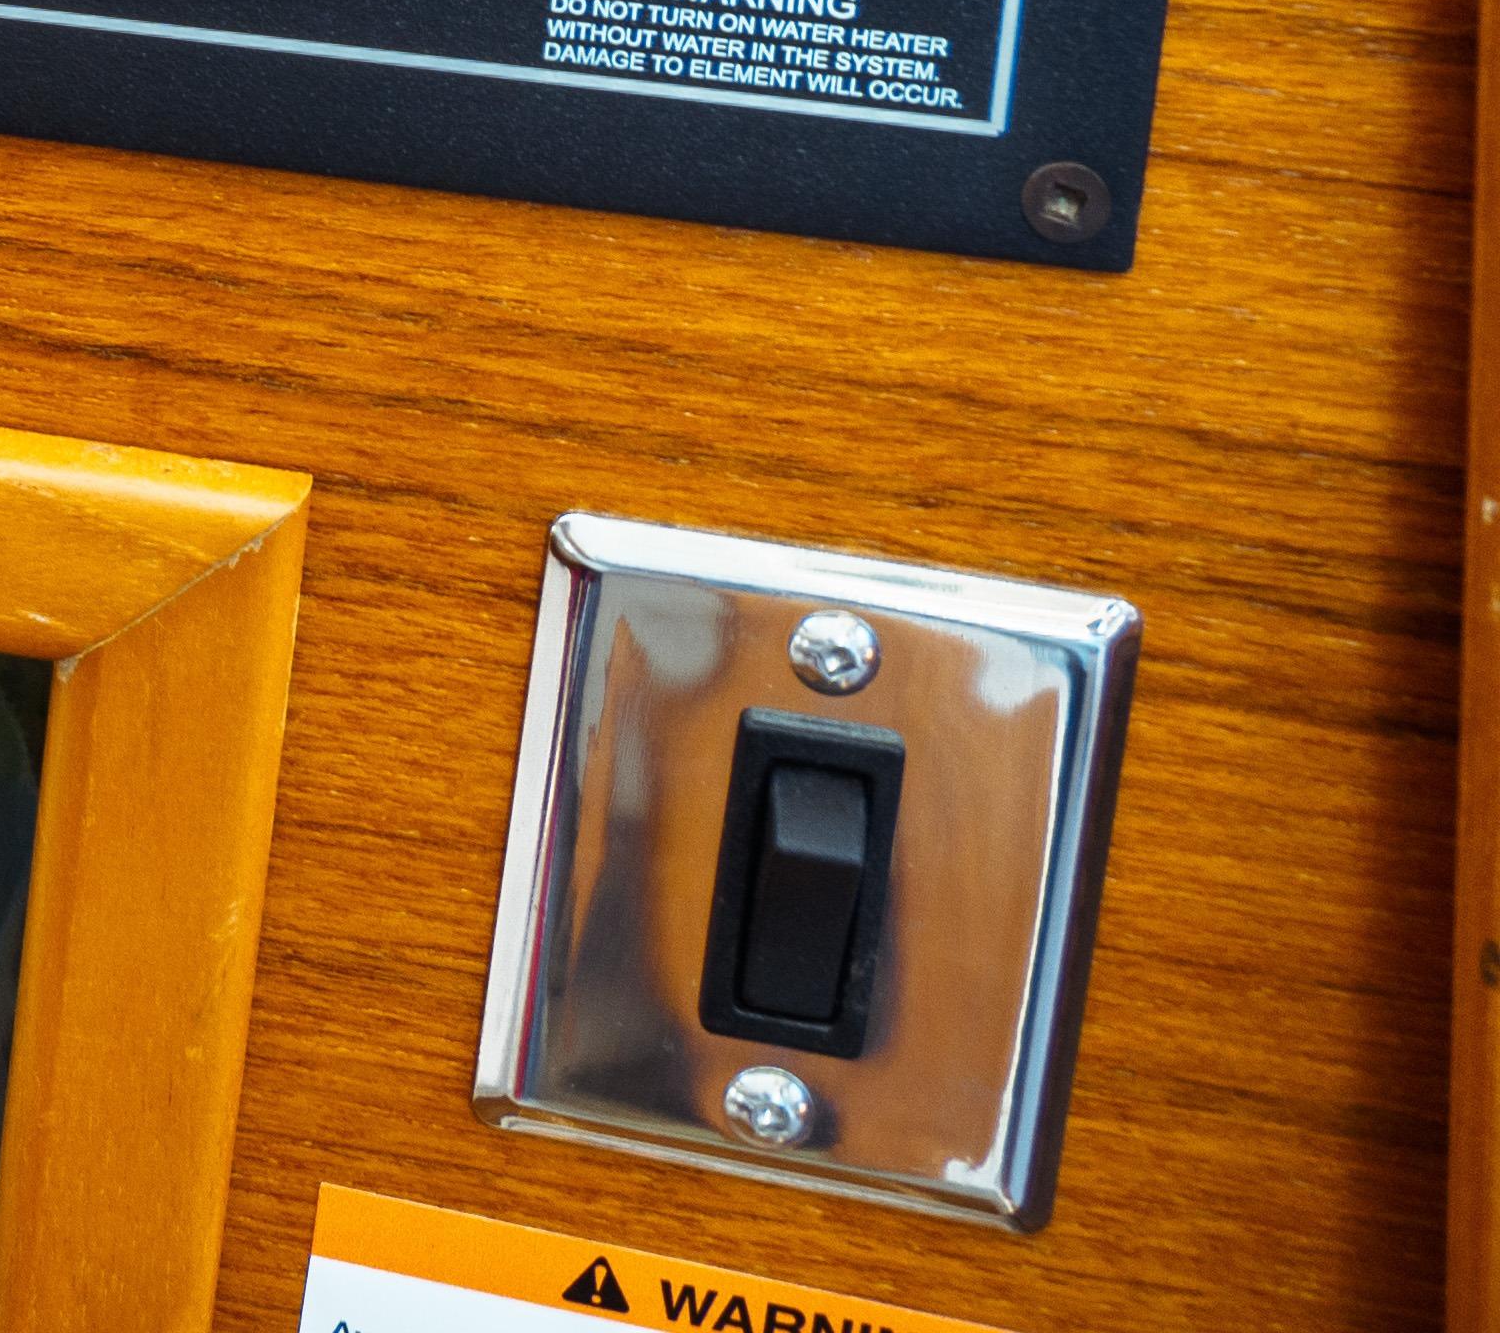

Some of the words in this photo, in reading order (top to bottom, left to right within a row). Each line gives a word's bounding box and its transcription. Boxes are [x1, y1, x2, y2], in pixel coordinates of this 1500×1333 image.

[546, 19, 657, 48] WITHOUT
[662, 31, 745, 59] WATER
[751, 43, 775, 62] IN
[781, 45, 830, 69] THE
[834, 52, 941, 82] SYSTEM.
[647, 4, 714, 30] TURN
[718, 12, 756, 34] ON
[760, 18, 845, 46] WATER
[851, 29, 948, 57] HEATER
[543, 41, 646, 72] DAMAGE
[651, 53, 683, 76] TO
[689, 59, 803, 90] ELEMENT
[807, 73, 863, 97] WILL
[868, 79, 963, 109] OCCUR.
